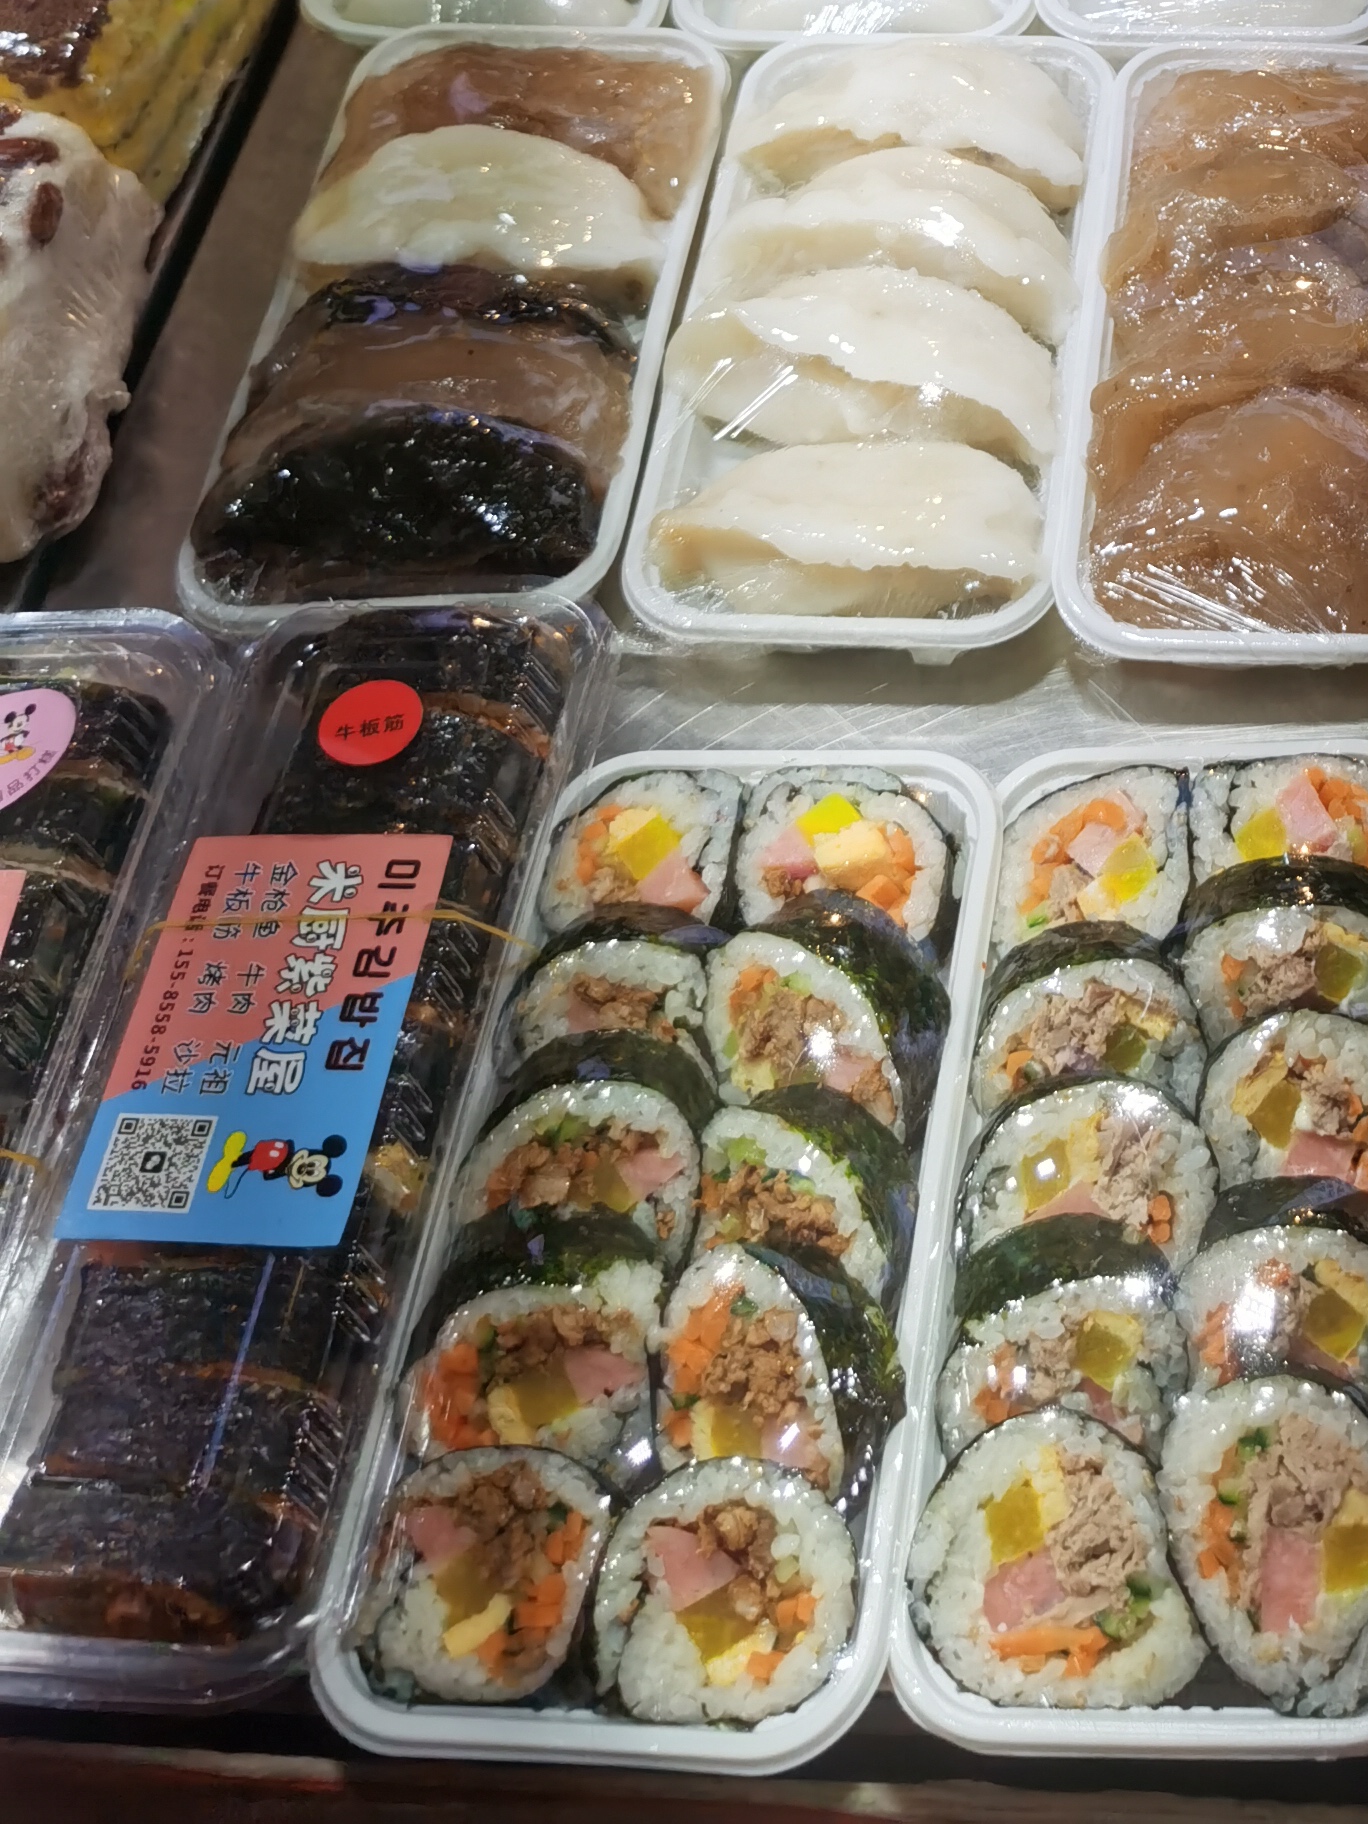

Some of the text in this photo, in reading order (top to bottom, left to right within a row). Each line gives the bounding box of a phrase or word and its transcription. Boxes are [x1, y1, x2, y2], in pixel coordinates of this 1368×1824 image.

[335, 714, 404, 741] 牛板筋
[190, 962, 226, 1015] 烤肉
[199, 862, 297, 1095] 金枪鱼 牛肉 元祖
[246, 860, 363, 1095] 米厨紫菜屋
[162, 1040, 198, 1095] 沙拉
